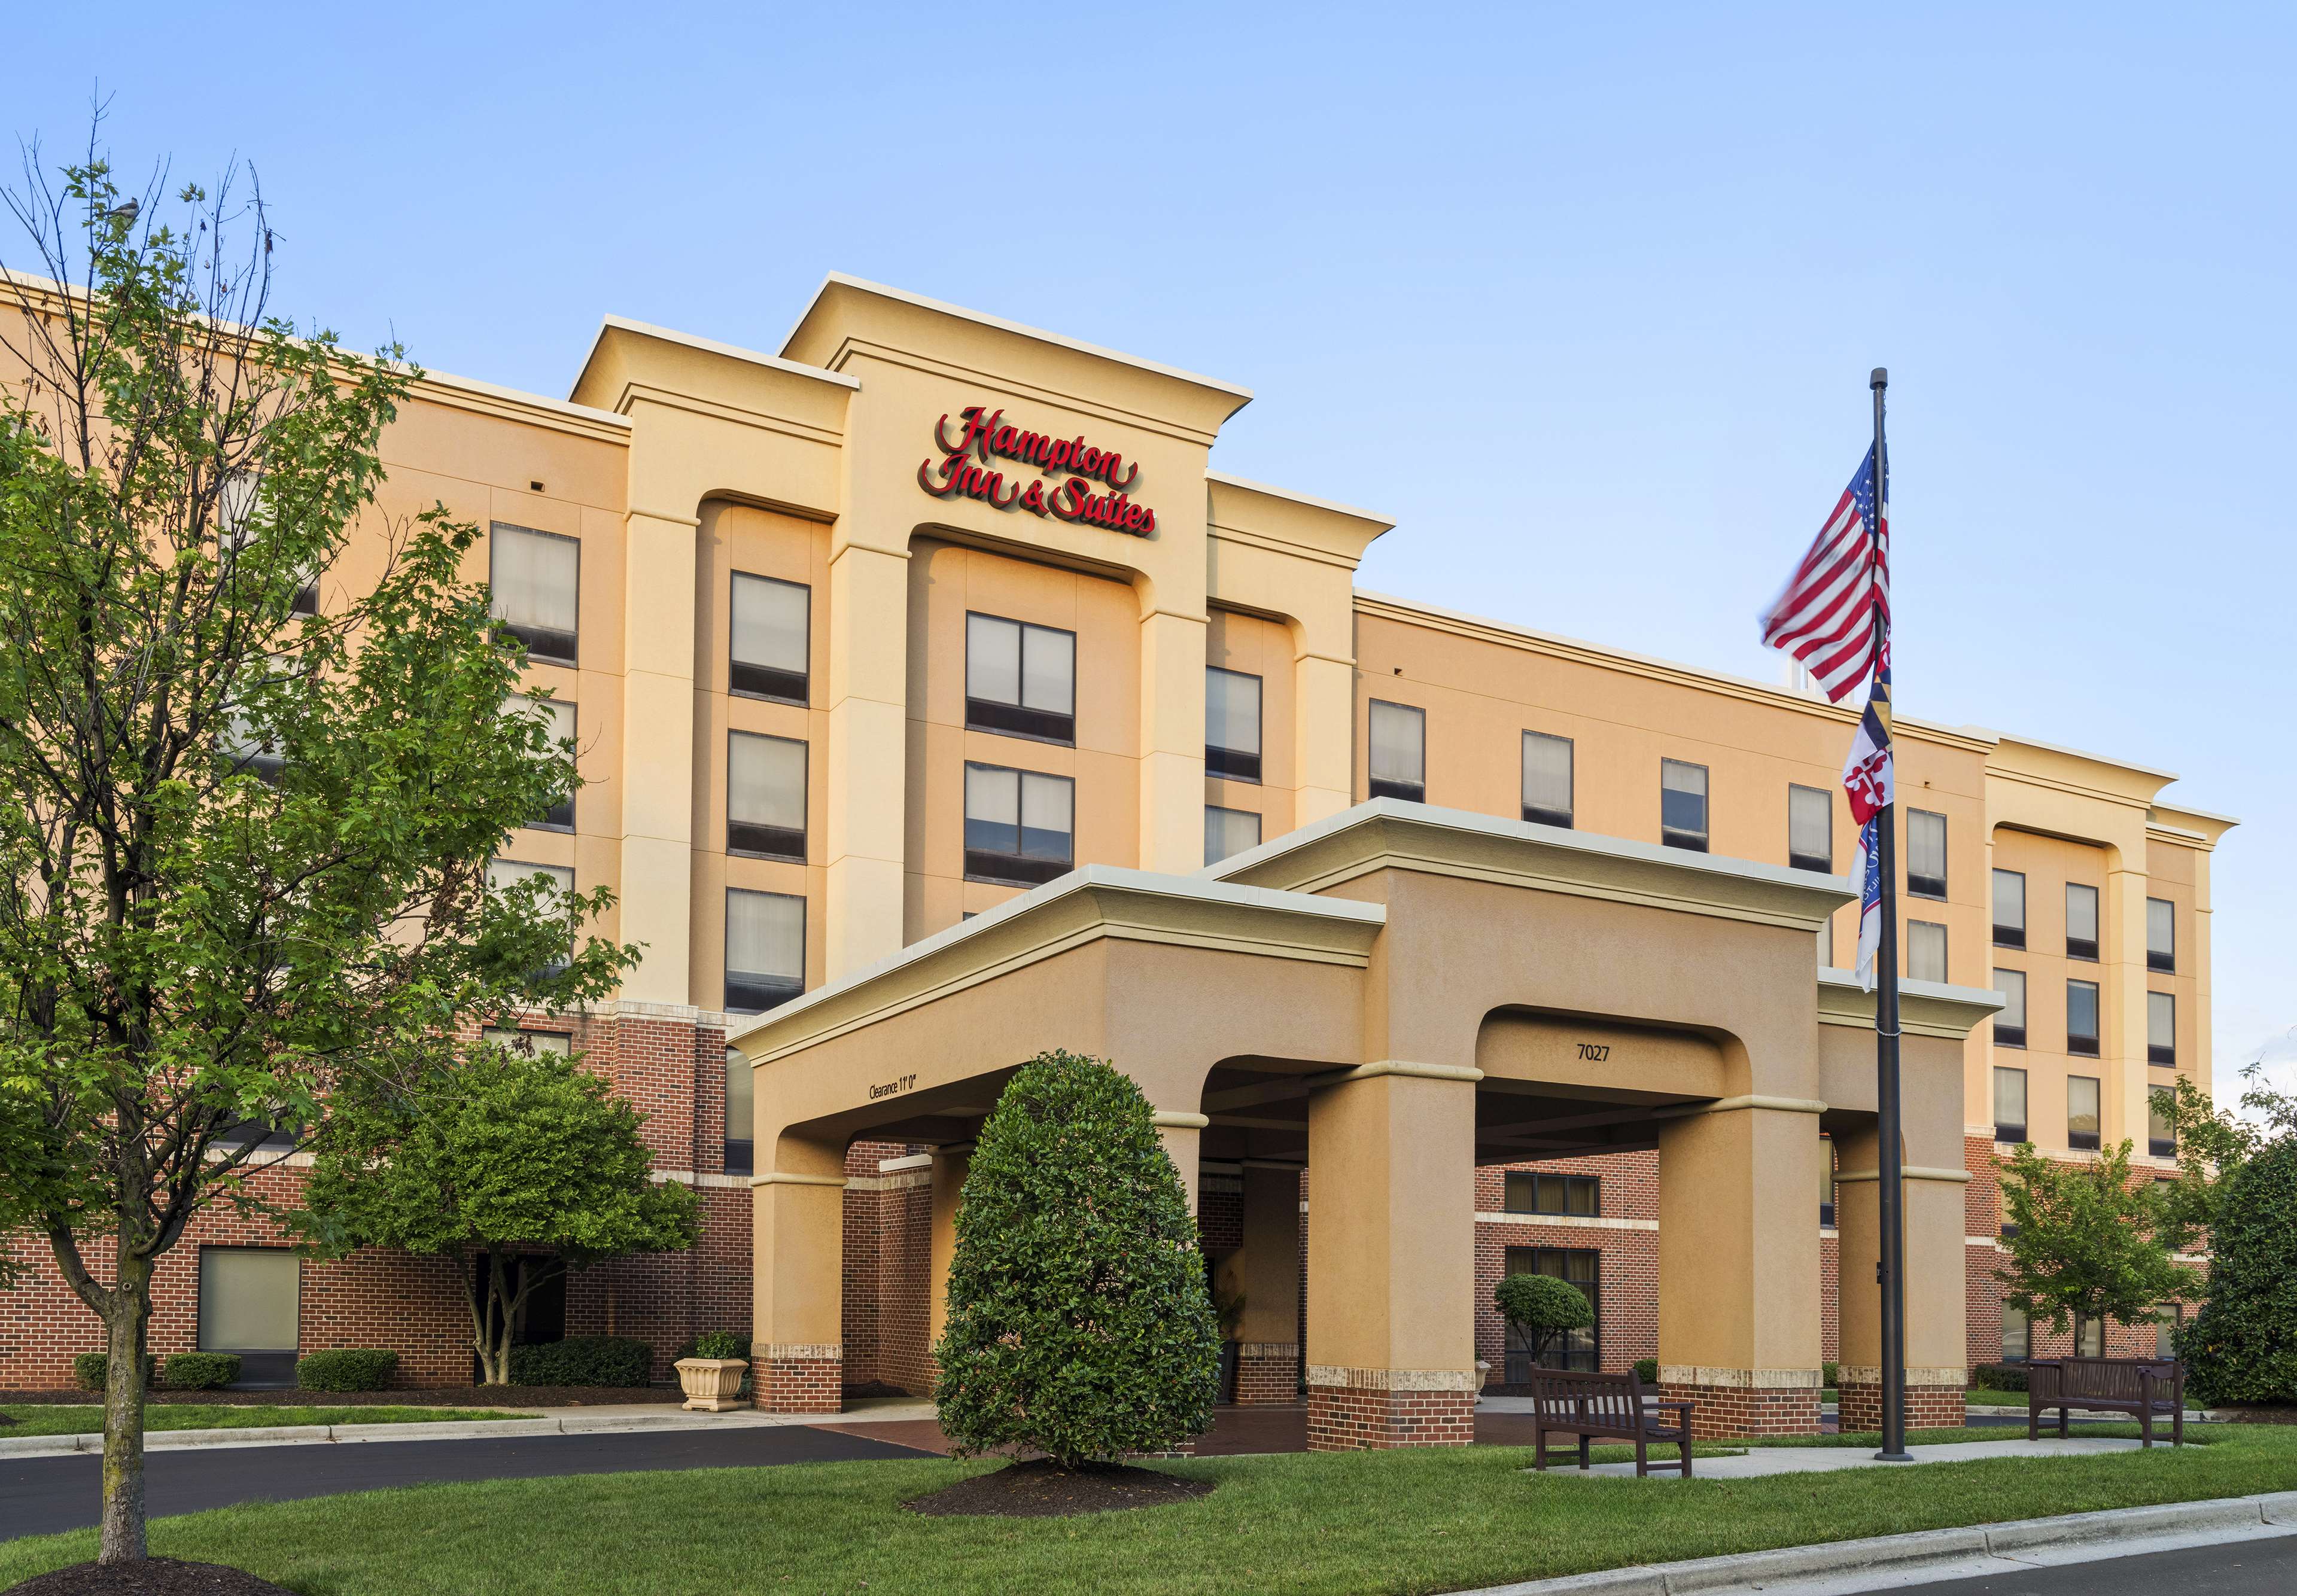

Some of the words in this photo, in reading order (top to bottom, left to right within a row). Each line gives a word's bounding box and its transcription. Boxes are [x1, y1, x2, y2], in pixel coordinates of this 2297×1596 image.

[935, 407, 1138, 490] Hampton
[918, 453, 1020, 509] Inn
[1020, 479, 1049, 517] &
[1048, 477, 1155, 537] Suites
[1577, 1043, 1610, 1062] 7027
[869, 1082, 898, 1099] Clearance
